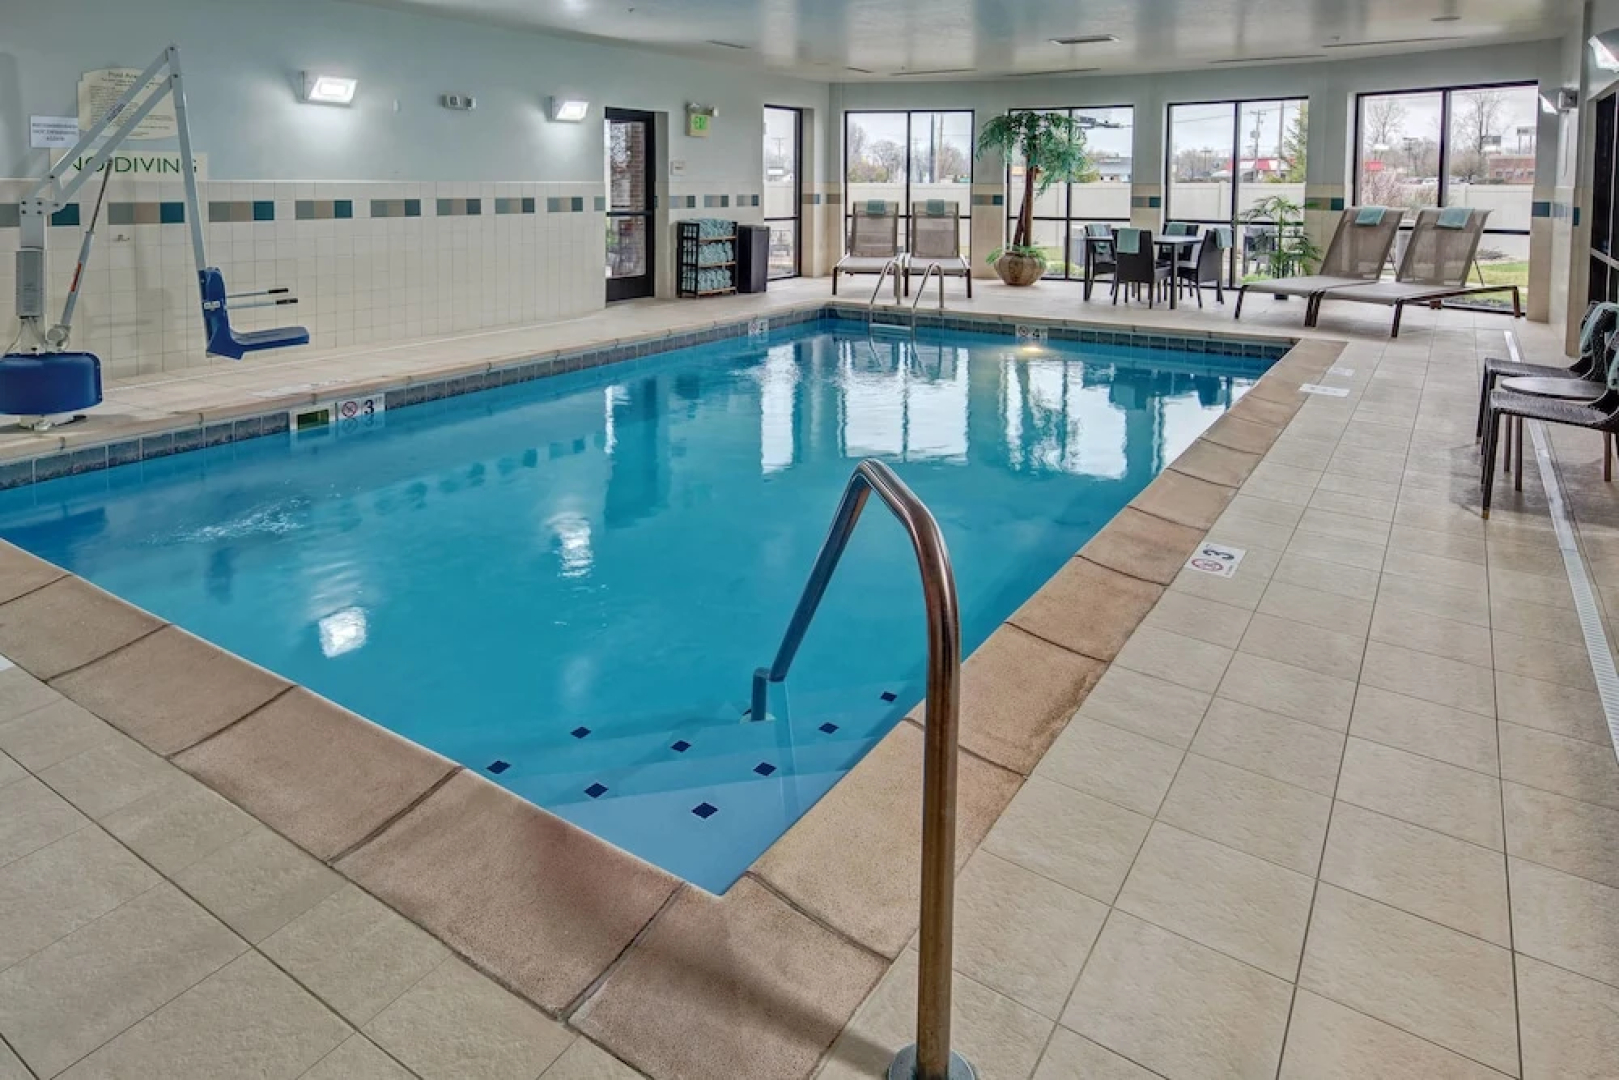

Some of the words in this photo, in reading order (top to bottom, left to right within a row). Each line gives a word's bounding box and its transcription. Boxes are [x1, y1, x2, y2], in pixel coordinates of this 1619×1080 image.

[114, 155, 197, 174] DIVIN
[363, 399, 375, 415] 3
[1202, 548, 1235, 561] 3
